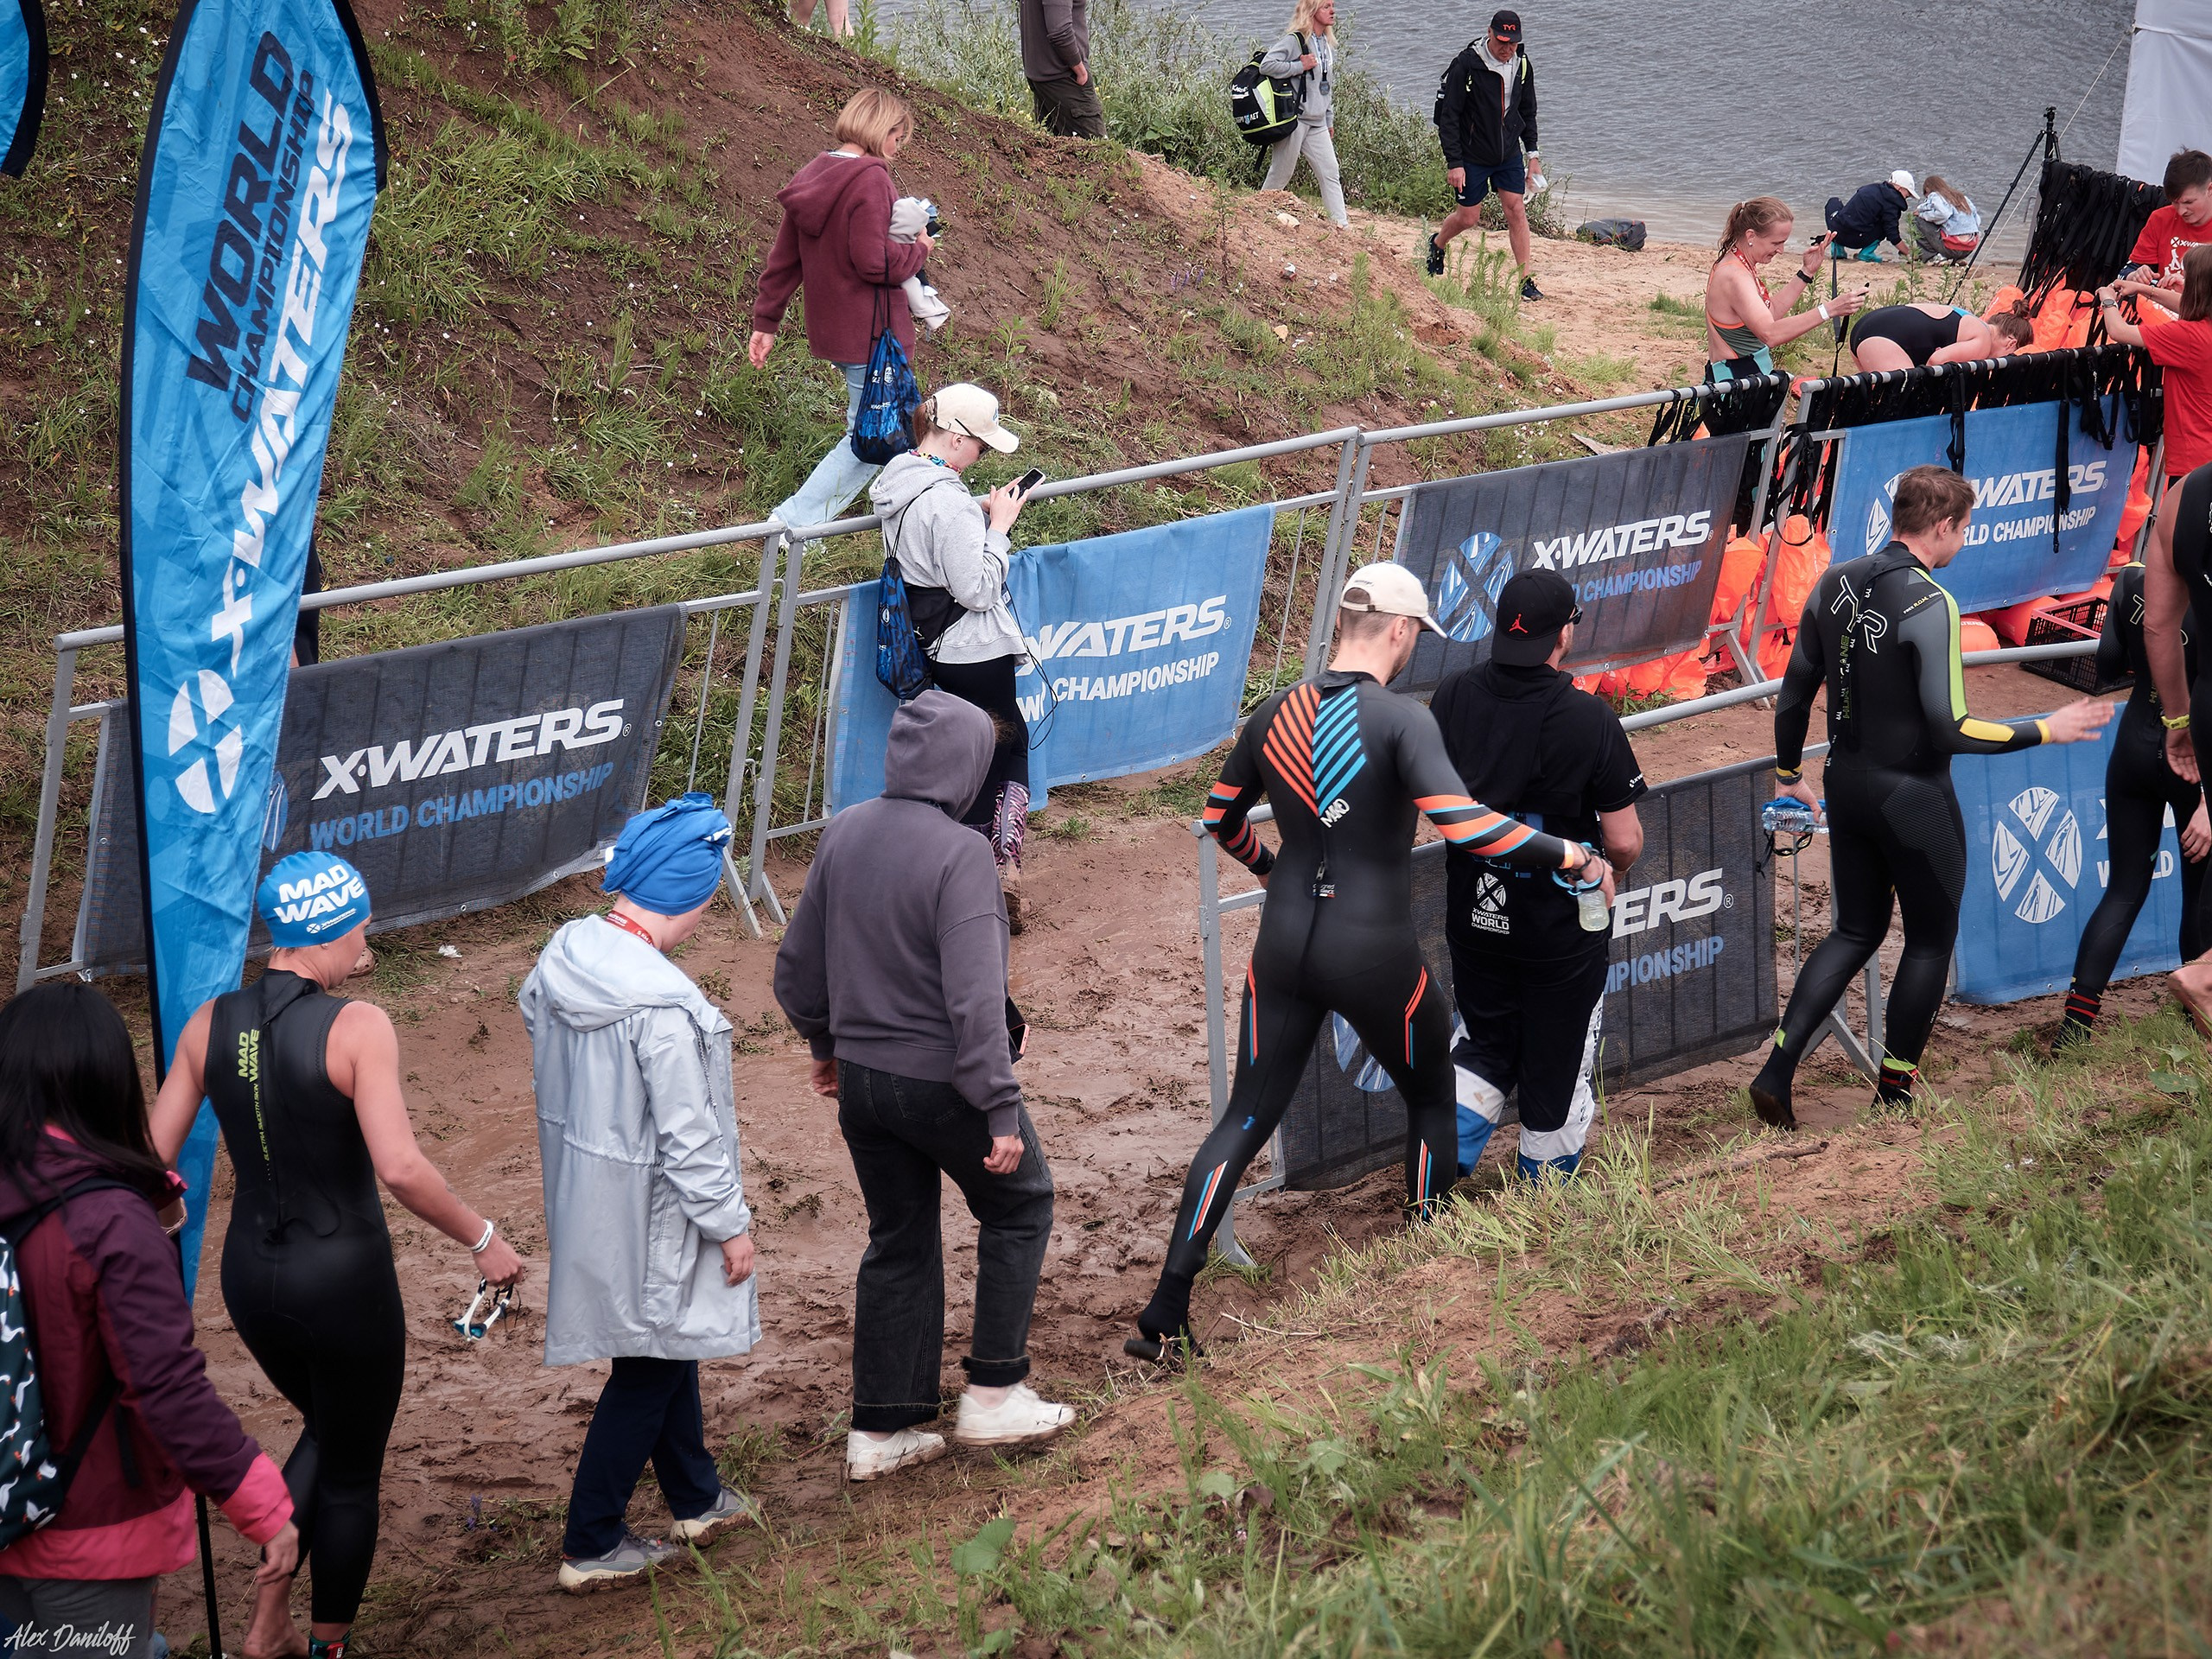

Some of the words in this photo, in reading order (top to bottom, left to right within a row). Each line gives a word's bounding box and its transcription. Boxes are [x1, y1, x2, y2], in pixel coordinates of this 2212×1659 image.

[188, 31, 295, 391] WORLD
[230, 69, 315, 423] CHAMPIONSHIP
[1583, 560, 1702, 602] CHAMPIONSHIP
[1864, 588, 1872, 599] TYR
[1051, 652, 1219, 702] CHAMPIONSHIP
[310, 804, 410, 851] WORLD
[417, 761, 614, 829] CHAMPIONSHIP
[273, 876, 365, 924] WAVE
[279, 864, 349, 904] MAD
[1471, 912, 1510, 931] WORLD
[1471, 922, 1510, 935] CHAMPIONSHIP
[238, 1031, 249, 1078] MAD
[249, 1028, 260, 1084] WAVE
[253, 1102, 264, 1131] SMOOTH
